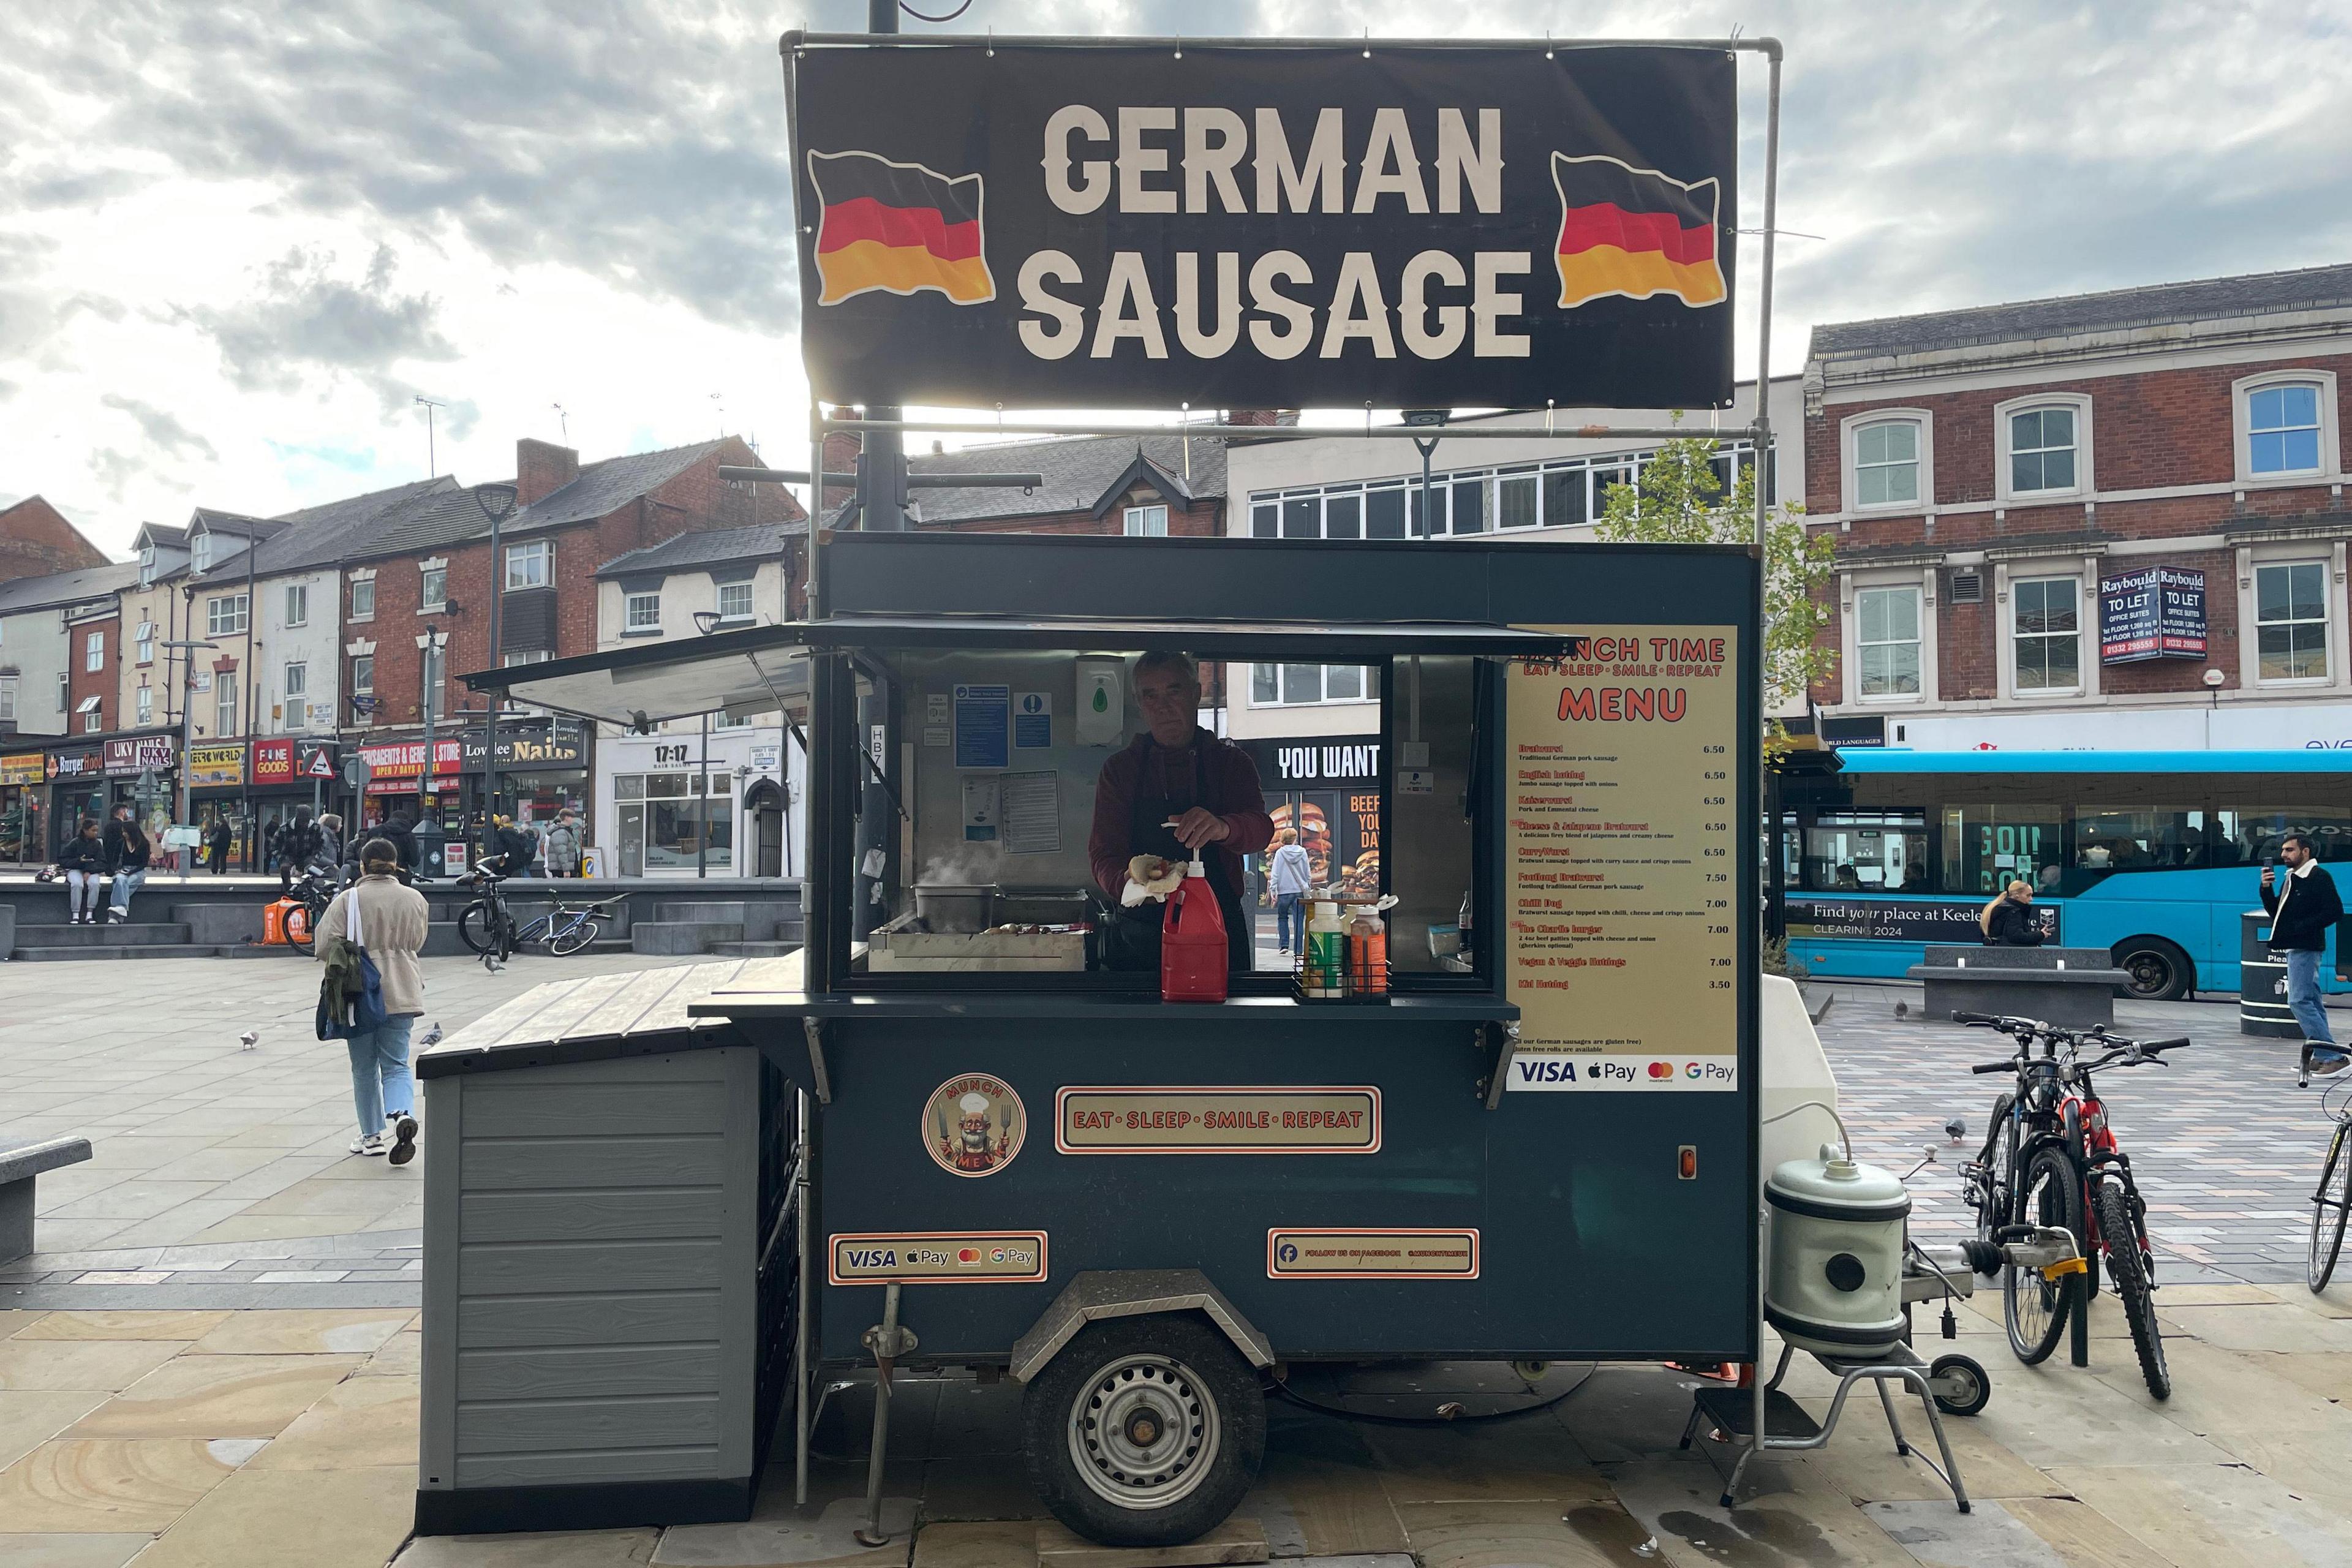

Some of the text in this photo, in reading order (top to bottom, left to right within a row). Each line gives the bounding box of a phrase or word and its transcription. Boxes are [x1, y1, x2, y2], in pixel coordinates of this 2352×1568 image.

[1041, 105, 1506, 214] GERMAN
[1017, 249, 1531, 358] SAUSAGE
[2101, 571, 2157, 593] Raybould
[2160, 570, 2204, 587] Raybould
[2108, 594, 2150, 611] TO LET
[2166, 592, 2199, 606] TO LET
[2109, 610, 2150, 622] OFFICE SUITES
[1649, 638, 1725, 662] TIME
[2107, 640, 2154, 654] 01332 295555
[1523, 663, 1722, 677] EAT SLEEP SMILE REPEAT
[1558, 687, 1686, 722] MENU
[556, 725, 578, 734] Lovelee
[114, 742, 133, 758] UKV
[143, 748, 167, 757] UKV
[359, 743, 459, 766] EWSAGENTS & GENEL STORE
[466, 742, 510, 756] Lovlee
[655, 745, 687, 762] 17:17
[141, 757, 170, 766] NAILS
[257, 761, 289, 774] GOODS
[1278, 744, 1380, 778] YOU WANT
[376, 766, 392, 776] OPEN
[394, 765, 397, 775] 7
[399, 764, 416, 774] DAYS
[1704, 771, 1726, 780] 6.50
[1351, 795, 1380, 812] BEEF
[1705, 823, 1727, 831] 6.50
[1361, 831, 1380, 848] DA
[1705, 873, 1727, 882] 7.50
[1544, 899, 1562, 908] Dog
[1814, 905, 1845, 918] Find
[1883, 909, 1922, 923] place
[1924, 910, 1938, 921] at
[1942, 909, 1983, 922] Keele
[1572, 925, 1602, 935] burger
[1813, 925, 1902, 937] CLEARING 2024
[1710, 958, 1731, 967] 7.00
[1515, 1061, 1637, 1082] VISA Pay
[1685, 1062, 1735, 1083] G Pay
[946, 1080, 1003, 1099] MUNCH
[1072, 1110, 1364, 1130] EAT SLEEP SMILE REPEAT
[843, 1250, 897, 1268] VISA
[921, 1250, 949, 1266] Pay
[1008, 1249, 1034, 1265] Pay
